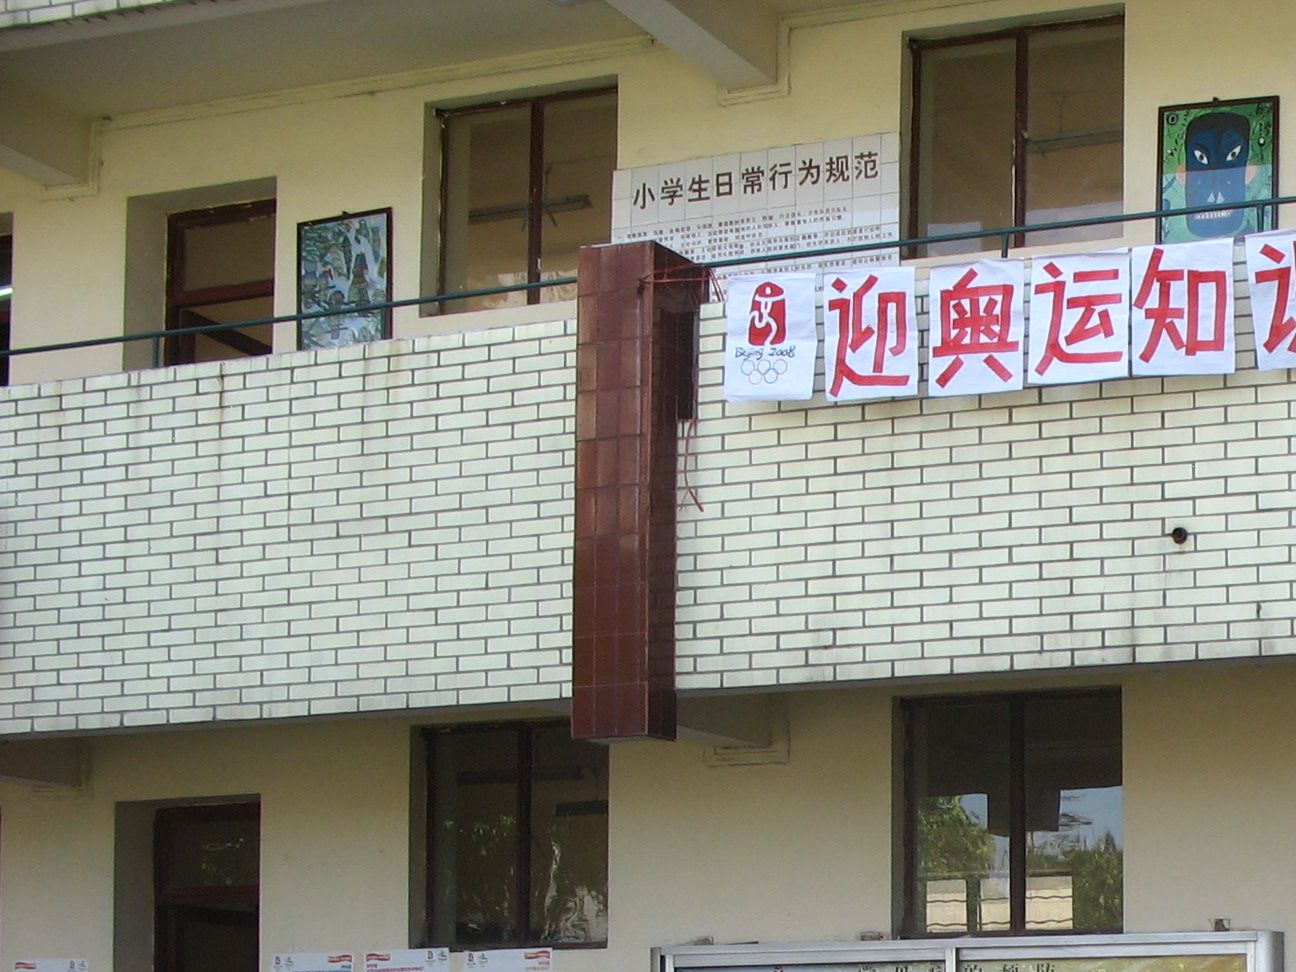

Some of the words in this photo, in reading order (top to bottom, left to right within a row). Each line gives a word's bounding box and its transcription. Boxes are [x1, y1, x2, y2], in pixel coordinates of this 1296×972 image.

[633, 150, 880, 209] 小学生日常行为规范
[768, 345, 796, 358] 2008
